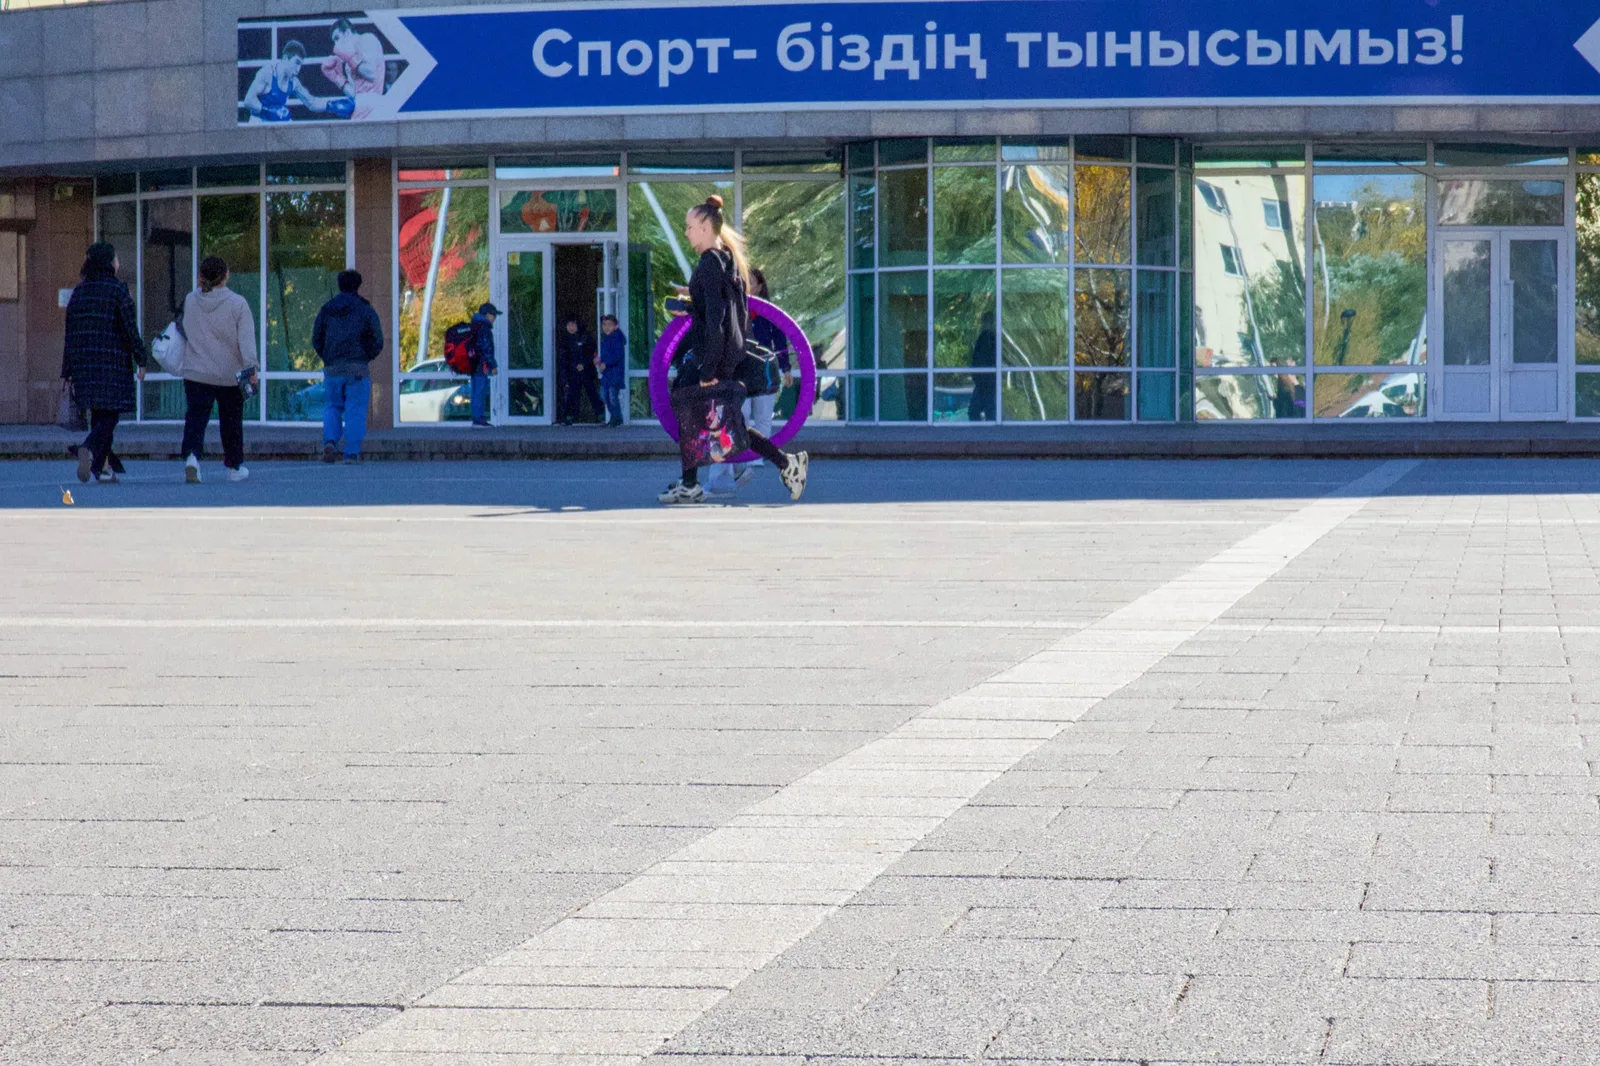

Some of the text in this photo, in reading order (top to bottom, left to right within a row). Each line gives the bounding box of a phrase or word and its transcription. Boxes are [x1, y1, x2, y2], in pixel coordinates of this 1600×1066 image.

[532, 15, 1464, 88] Спорт- біздің тынысымыз!
